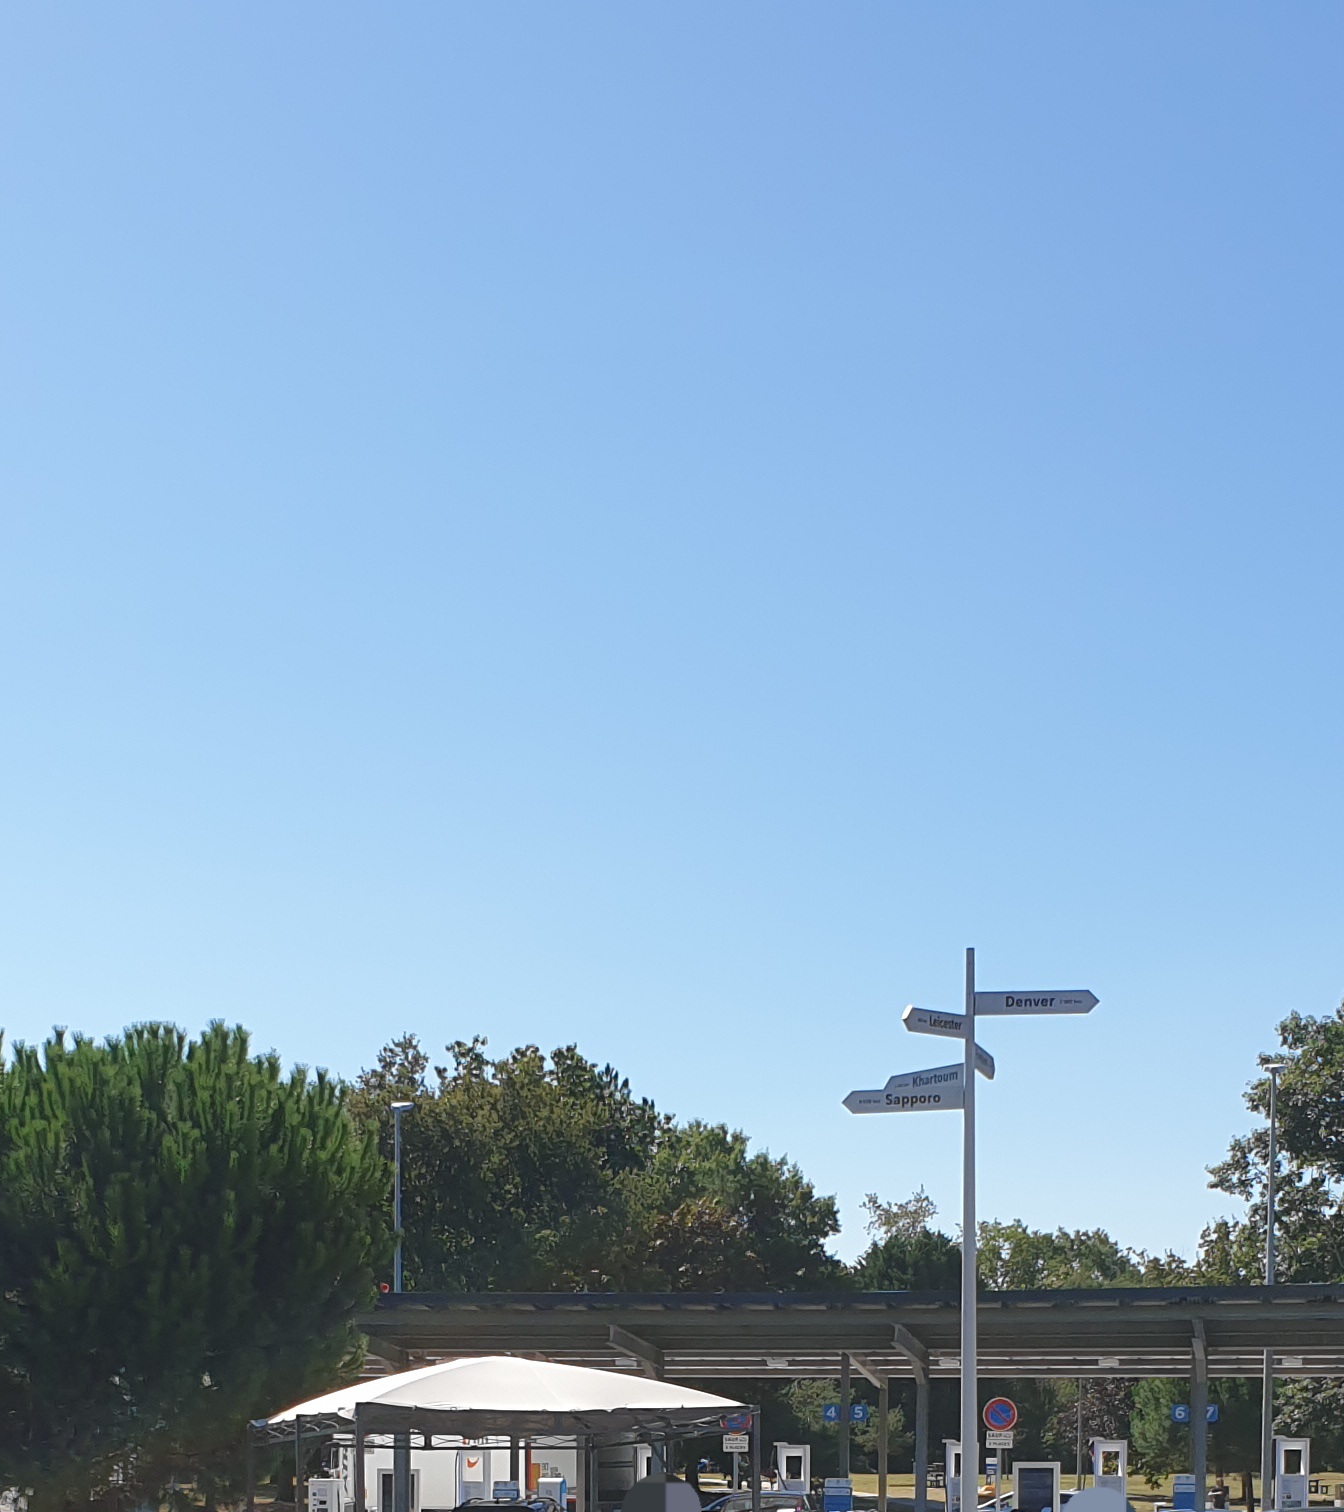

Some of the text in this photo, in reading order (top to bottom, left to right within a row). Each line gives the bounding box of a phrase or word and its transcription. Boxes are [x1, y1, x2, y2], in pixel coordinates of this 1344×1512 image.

[1005, 995, 1056, 1008] Denver
[929, 1015, 962, 1031] Leicester
[912, 1071, 958, 1088] Khartoum
[885, 1093, 941, 1108] Sapporo
[826, 1406, 836, 1418] 4
[854, 1406, 863, 1418] 5
[1175, 1406, 1185, 1419] 6
[1206, 1406, 1215, 1419] 7
